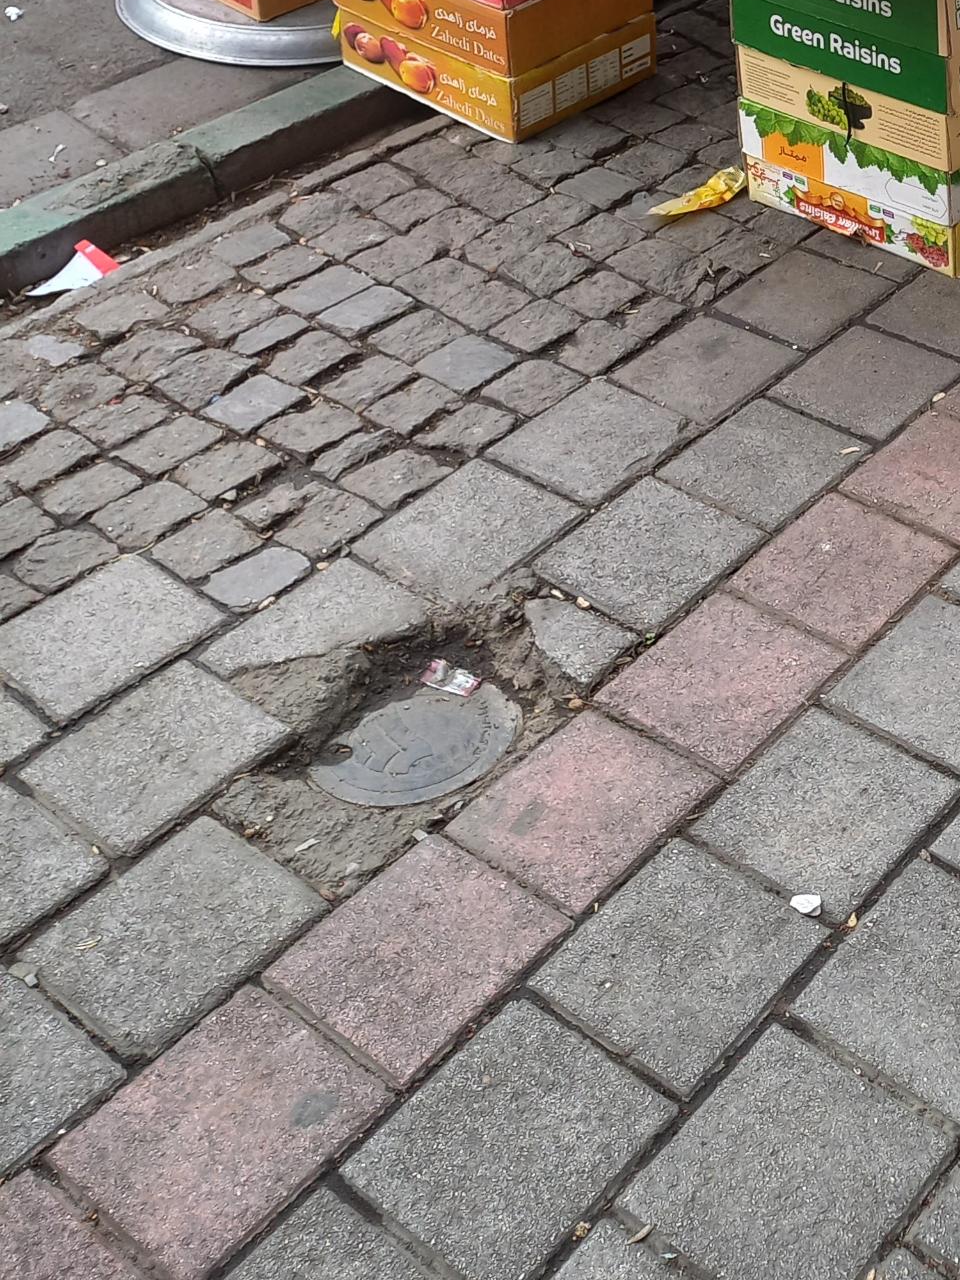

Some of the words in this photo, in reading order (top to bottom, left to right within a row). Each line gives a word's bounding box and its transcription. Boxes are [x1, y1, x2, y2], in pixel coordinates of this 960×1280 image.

[430, 22, 471, 52] Zahedi
[473, 40, 506, 66] Dates
[769, 14, 824, 50] Green
[829, 32, 902, 75] Raisins
[435, 87, 473, 117] Zahedi
[475, 104, 506, 134] Dates
[778, 144, 809, 164] ممتاز
